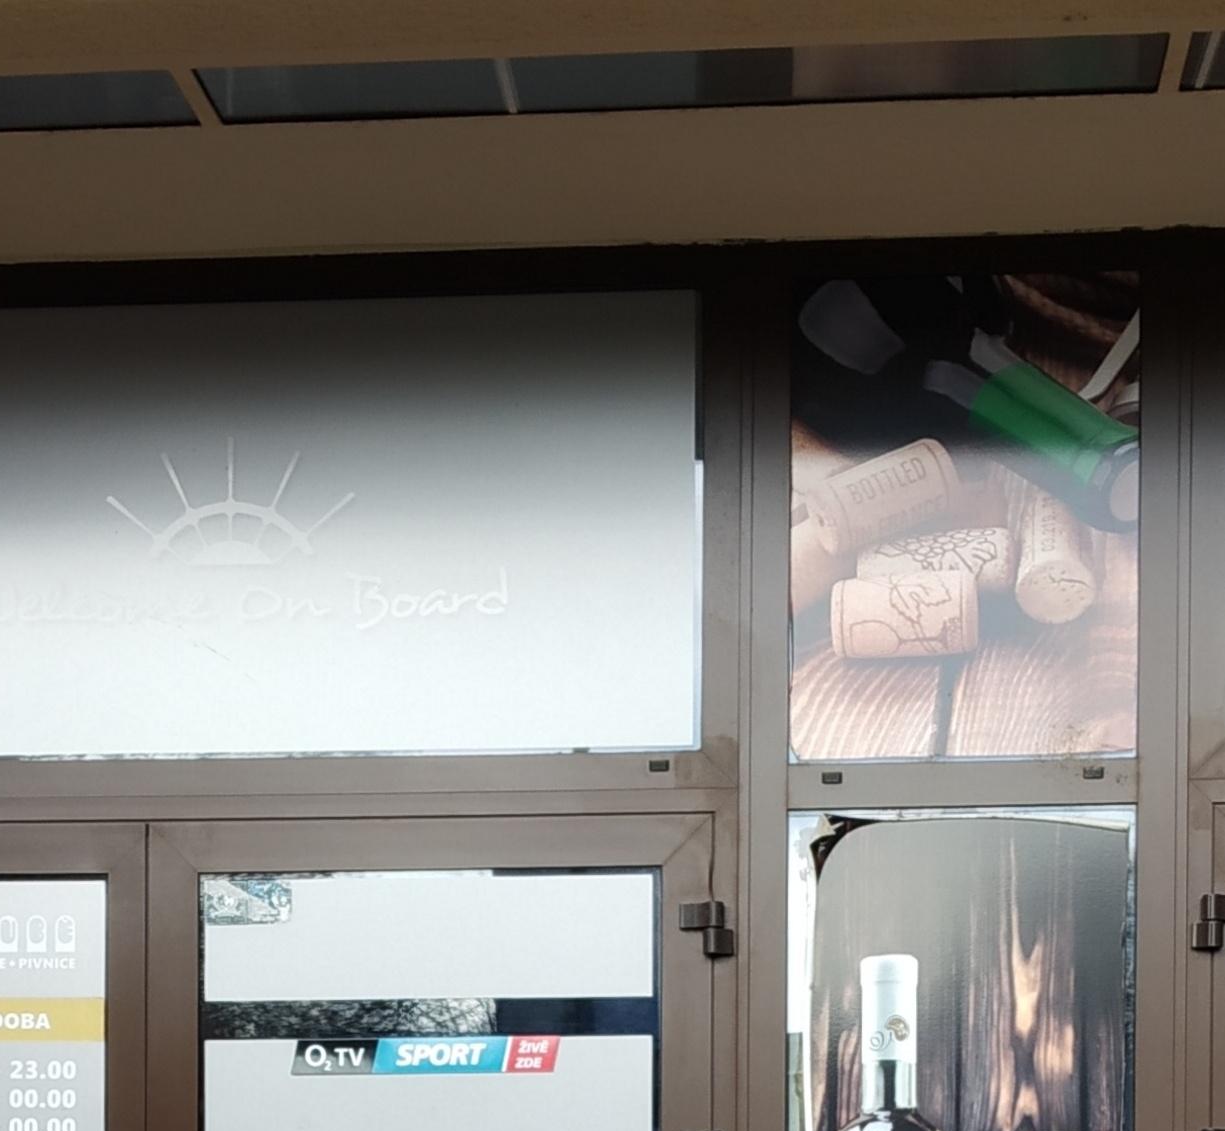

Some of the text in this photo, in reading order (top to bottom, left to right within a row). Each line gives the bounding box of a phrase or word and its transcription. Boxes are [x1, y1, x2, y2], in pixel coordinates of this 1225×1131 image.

[846, 456, 927, 505] BOTTLED
[239, 584, 332, 621] On
[345, 566, 510, 630] Board
[18, 957, 76, 970] PIVNICE
[334, 1047, 365, 1067] TV
[394, 1042, 488, 1067] SPORT
[517, 1039, 549, 1055] ŽIVĚ
[9, 1060, 76, 1080] 23.00
[514, 1056, 542, 1069] ZDE
[9, 1088, 76, 1109] 00.00
